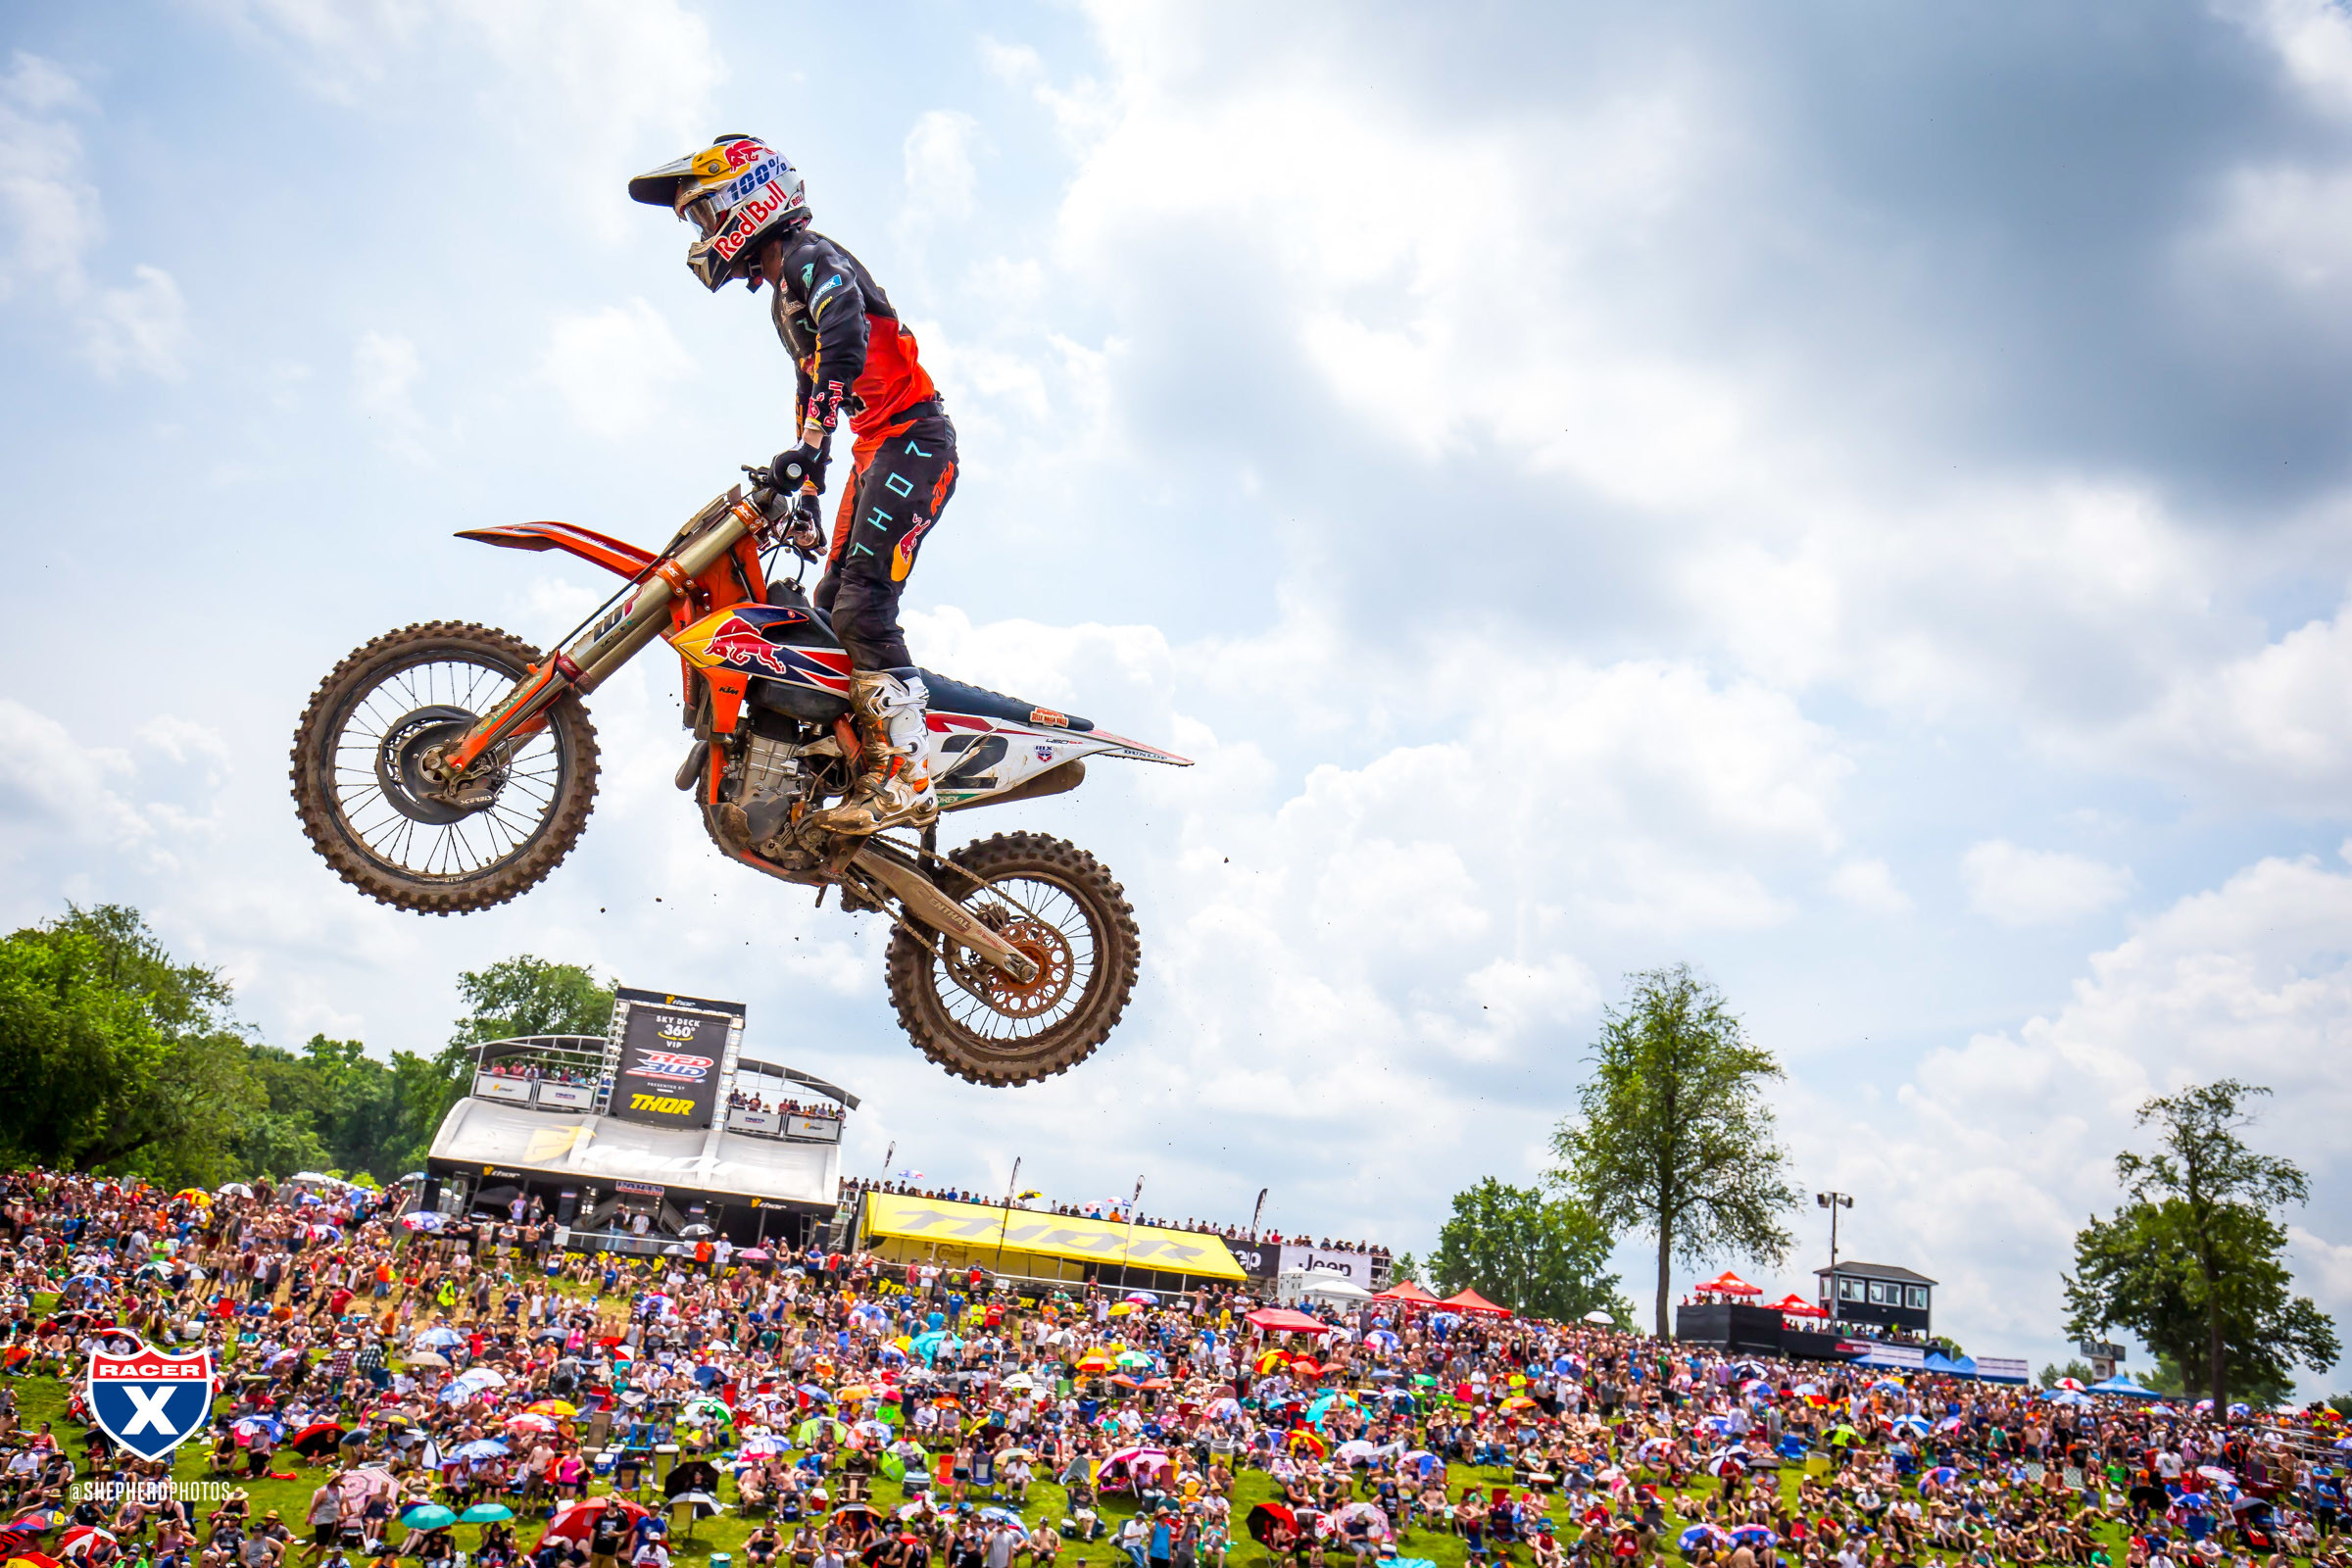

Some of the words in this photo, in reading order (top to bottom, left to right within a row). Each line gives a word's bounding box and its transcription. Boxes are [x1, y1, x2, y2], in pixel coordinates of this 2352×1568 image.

[726, 156, 788, 202] 100%
[792, 193, 804, 207] BELL
[712, 211, 759, 262] Red
[747, 179, 788, 224] Bull
[718, 686, 739, 696] KTM
[935, 735, 1009, 789] 2
[1124, 749, 1167, 760] DUNLOP
[931, 898, 971, 930] ENTHAL
[656, 1015, 675, 1024] SKY
[676, 1017, 701, 1028] DECK
[634, 1048, 714, 1068] RED
[629, 1060, 708, 1078] BUD
[629, 1094, 696, 1115] THOR
